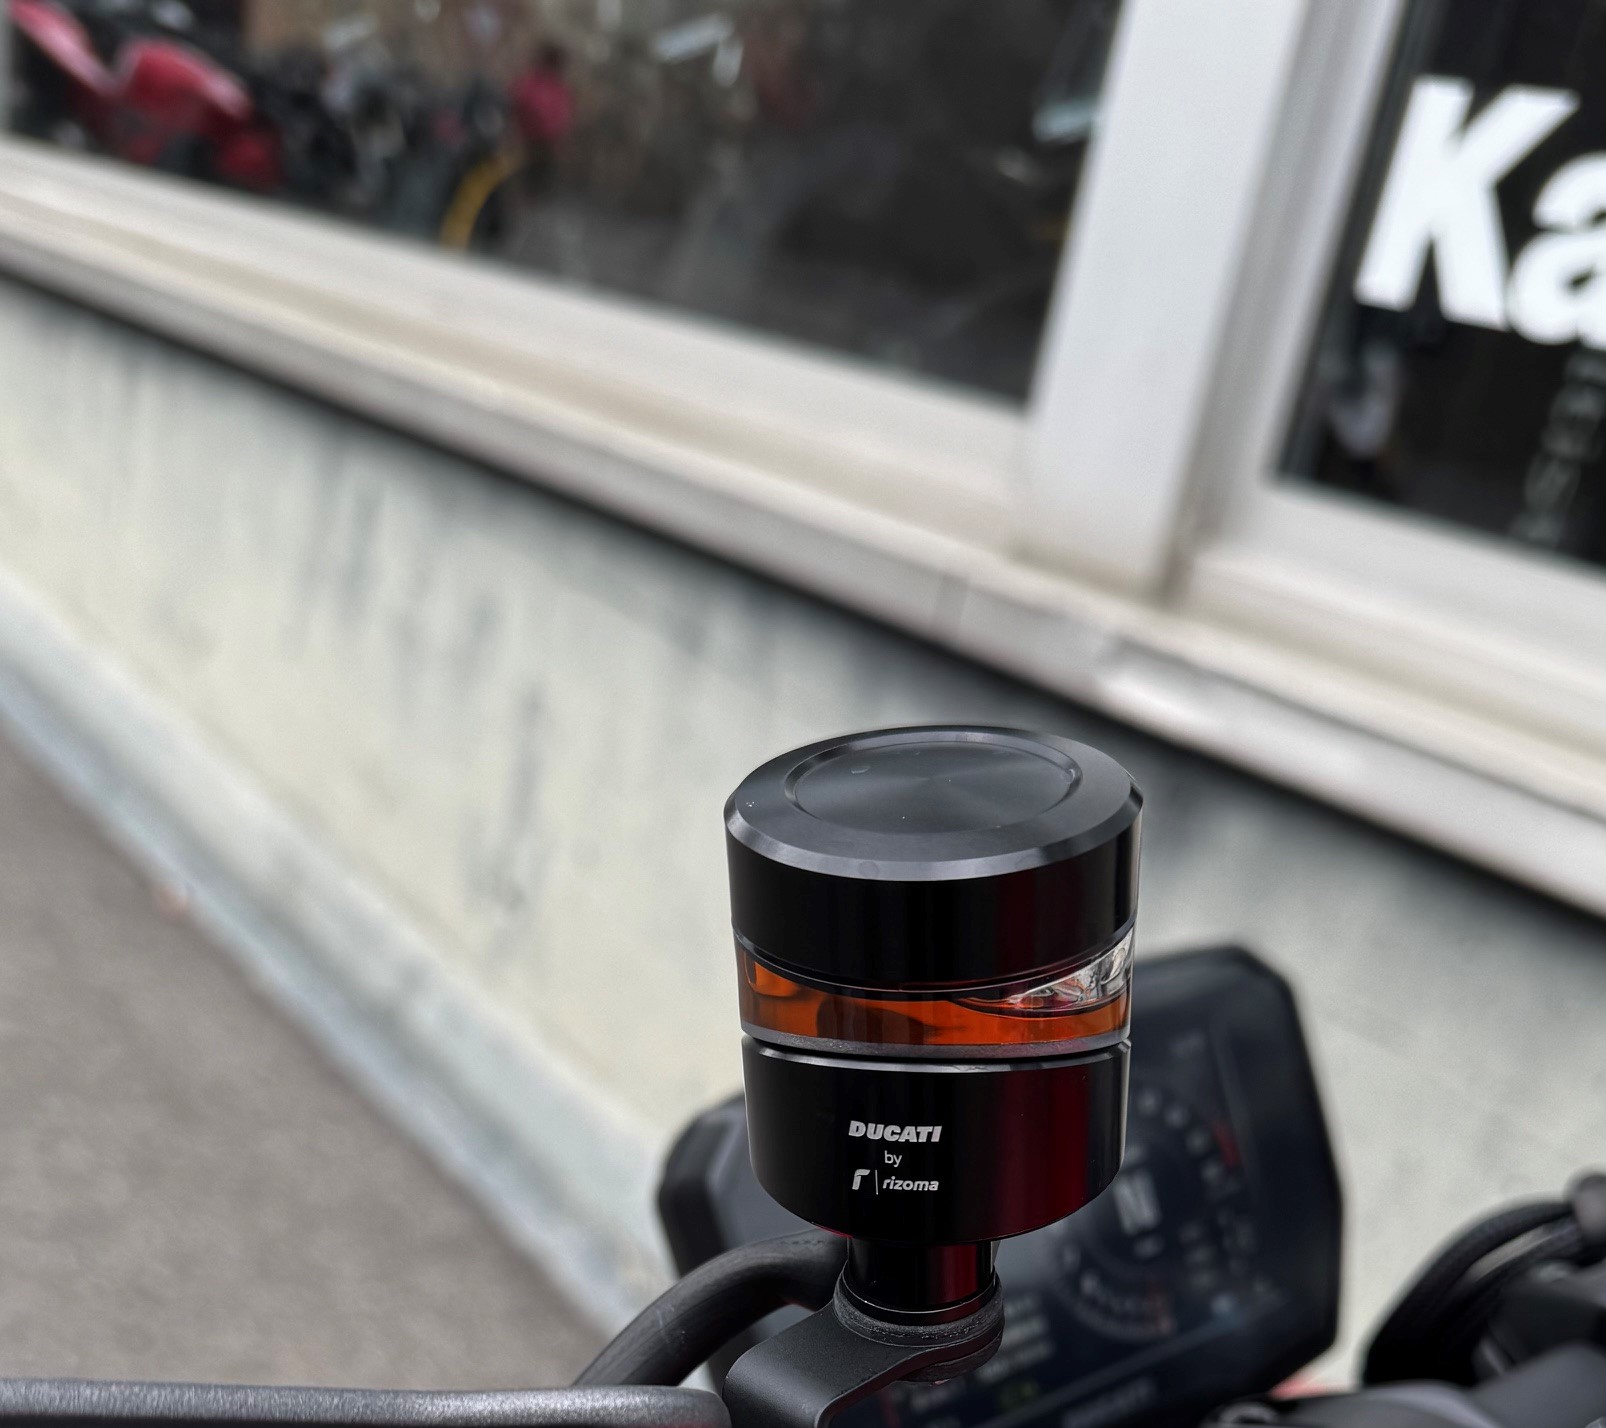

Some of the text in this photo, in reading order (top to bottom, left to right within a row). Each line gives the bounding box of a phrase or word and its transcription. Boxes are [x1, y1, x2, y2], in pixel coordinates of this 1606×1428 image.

[848, 1120, 943, 1143] DUCATI
[884, 1149, 903, 1168] by
[882, 1175, 940, 1192] rizoma
